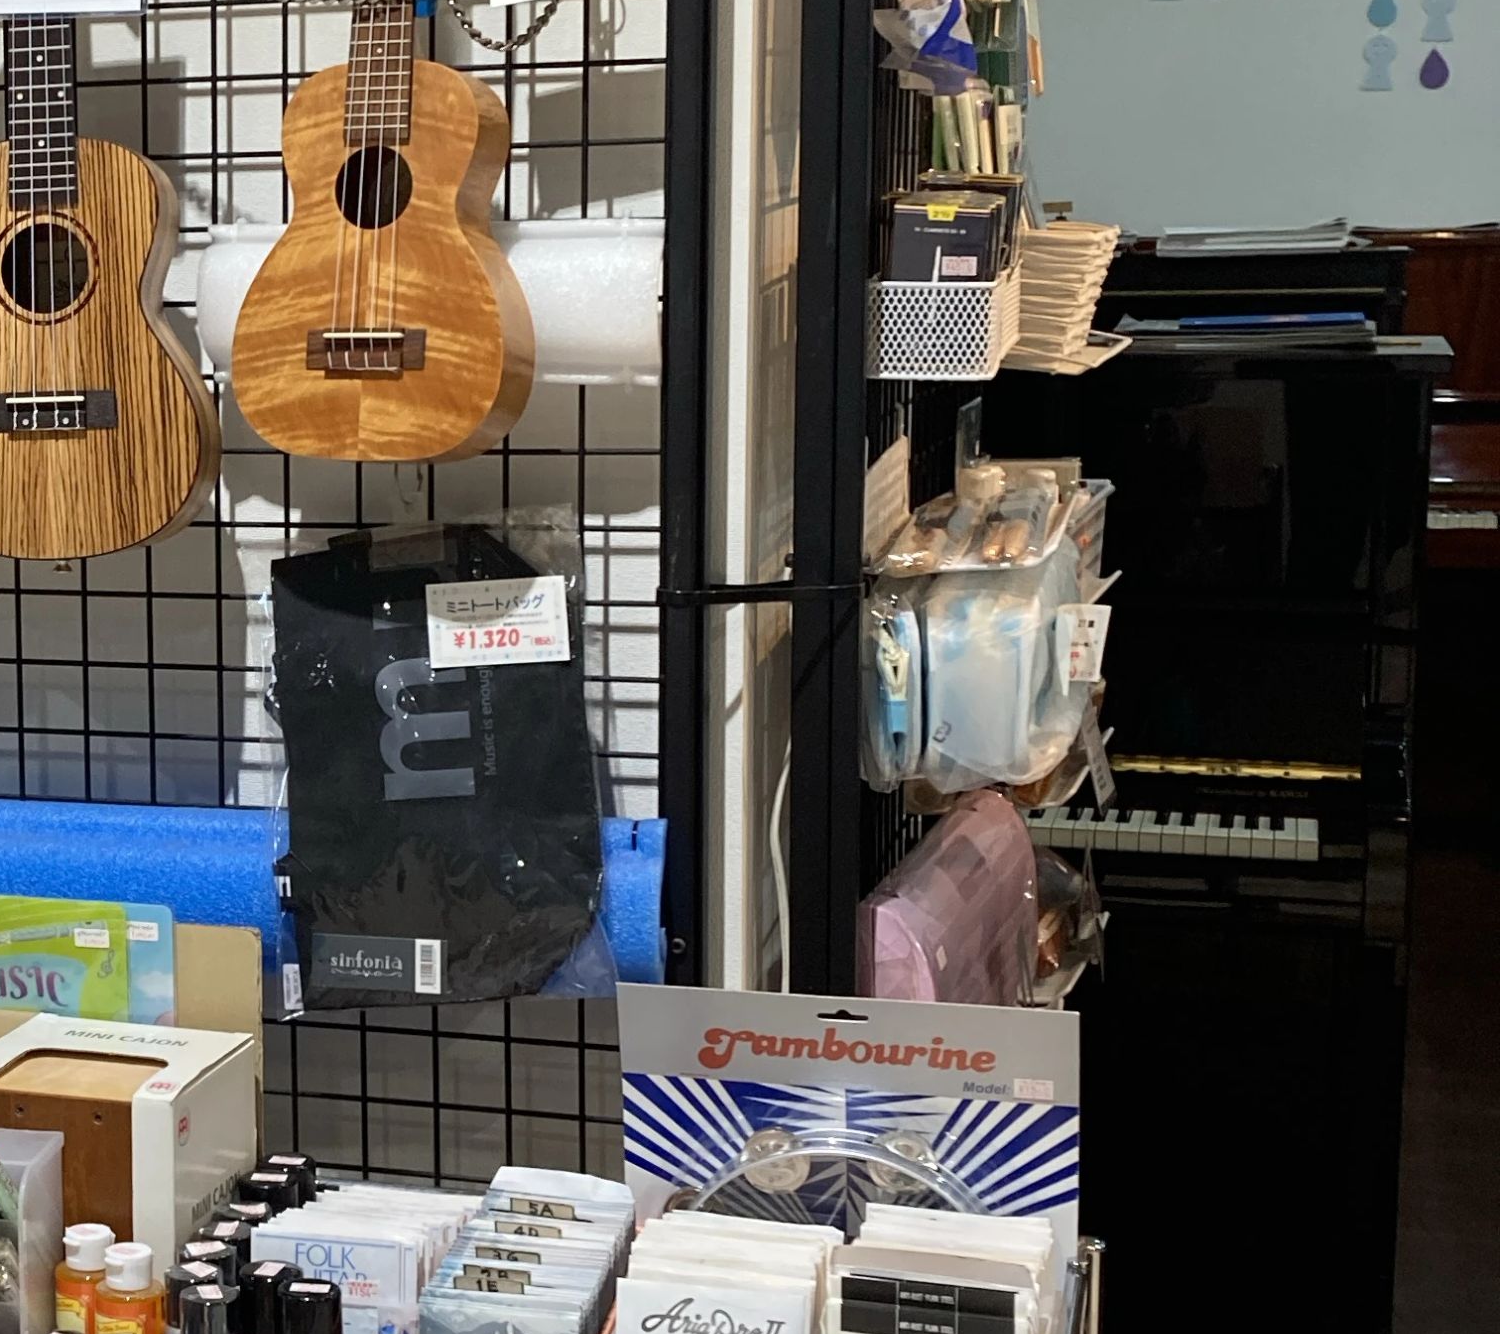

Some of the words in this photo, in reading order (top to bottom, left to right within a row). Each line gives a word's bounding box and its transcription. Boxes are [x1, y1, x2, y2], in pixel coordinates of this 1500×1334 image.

[446, 593, 545, 614] ミニトートバッグ
[330, 950, 404, 970] sinfonia
[64, 1028, 115, 1041] MINI
[118, 1034, 189, 1048] CAJON
[697, 1028, 997, 1073] Tambourine
[528, 1202, 554, 1218] 5A
[295, 1242, 356, 1270] FOLK
[642, 1298, 711, 1334] Aria
